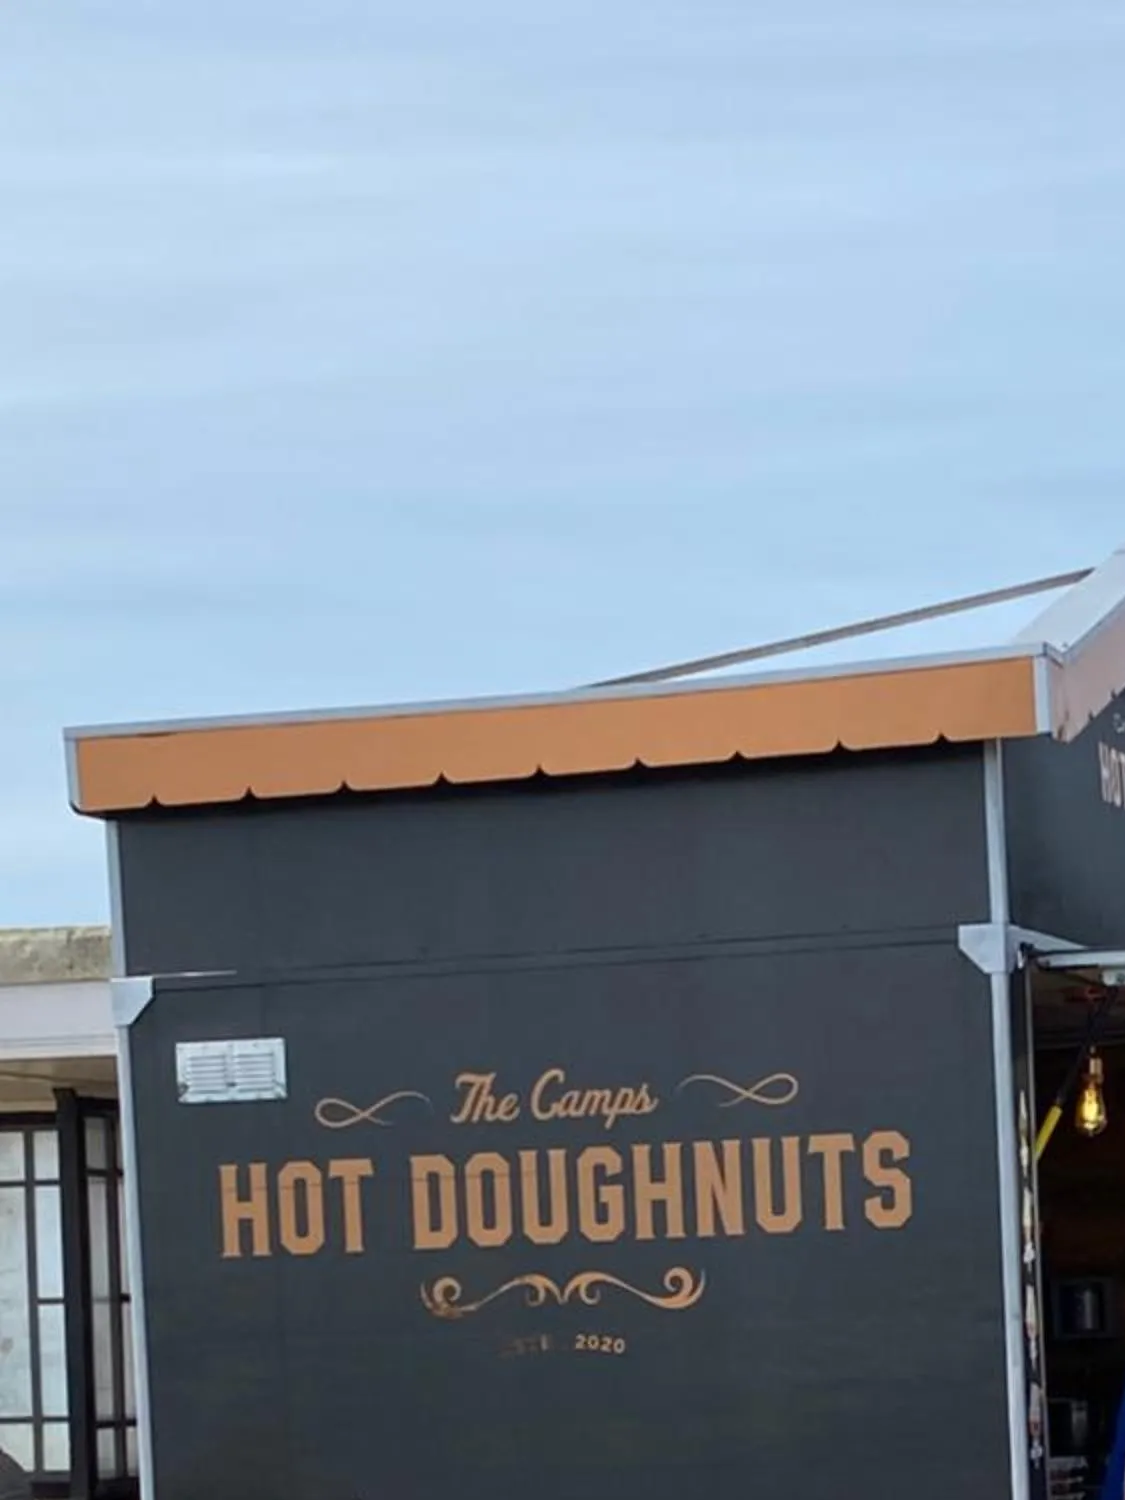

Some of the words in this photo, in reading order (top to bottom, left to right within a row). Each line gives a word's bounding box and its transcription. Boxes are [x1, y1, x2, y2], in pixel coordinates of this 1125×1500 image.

[450, 1073, 520, 1125] The
[531, 1068, 659, 1128] Camps
[218, 1157, 373, 1258] HOT
[409, 1130, 912, 1251] DOUGHNUTS
[574, 1332, 627, 1355] 2020
